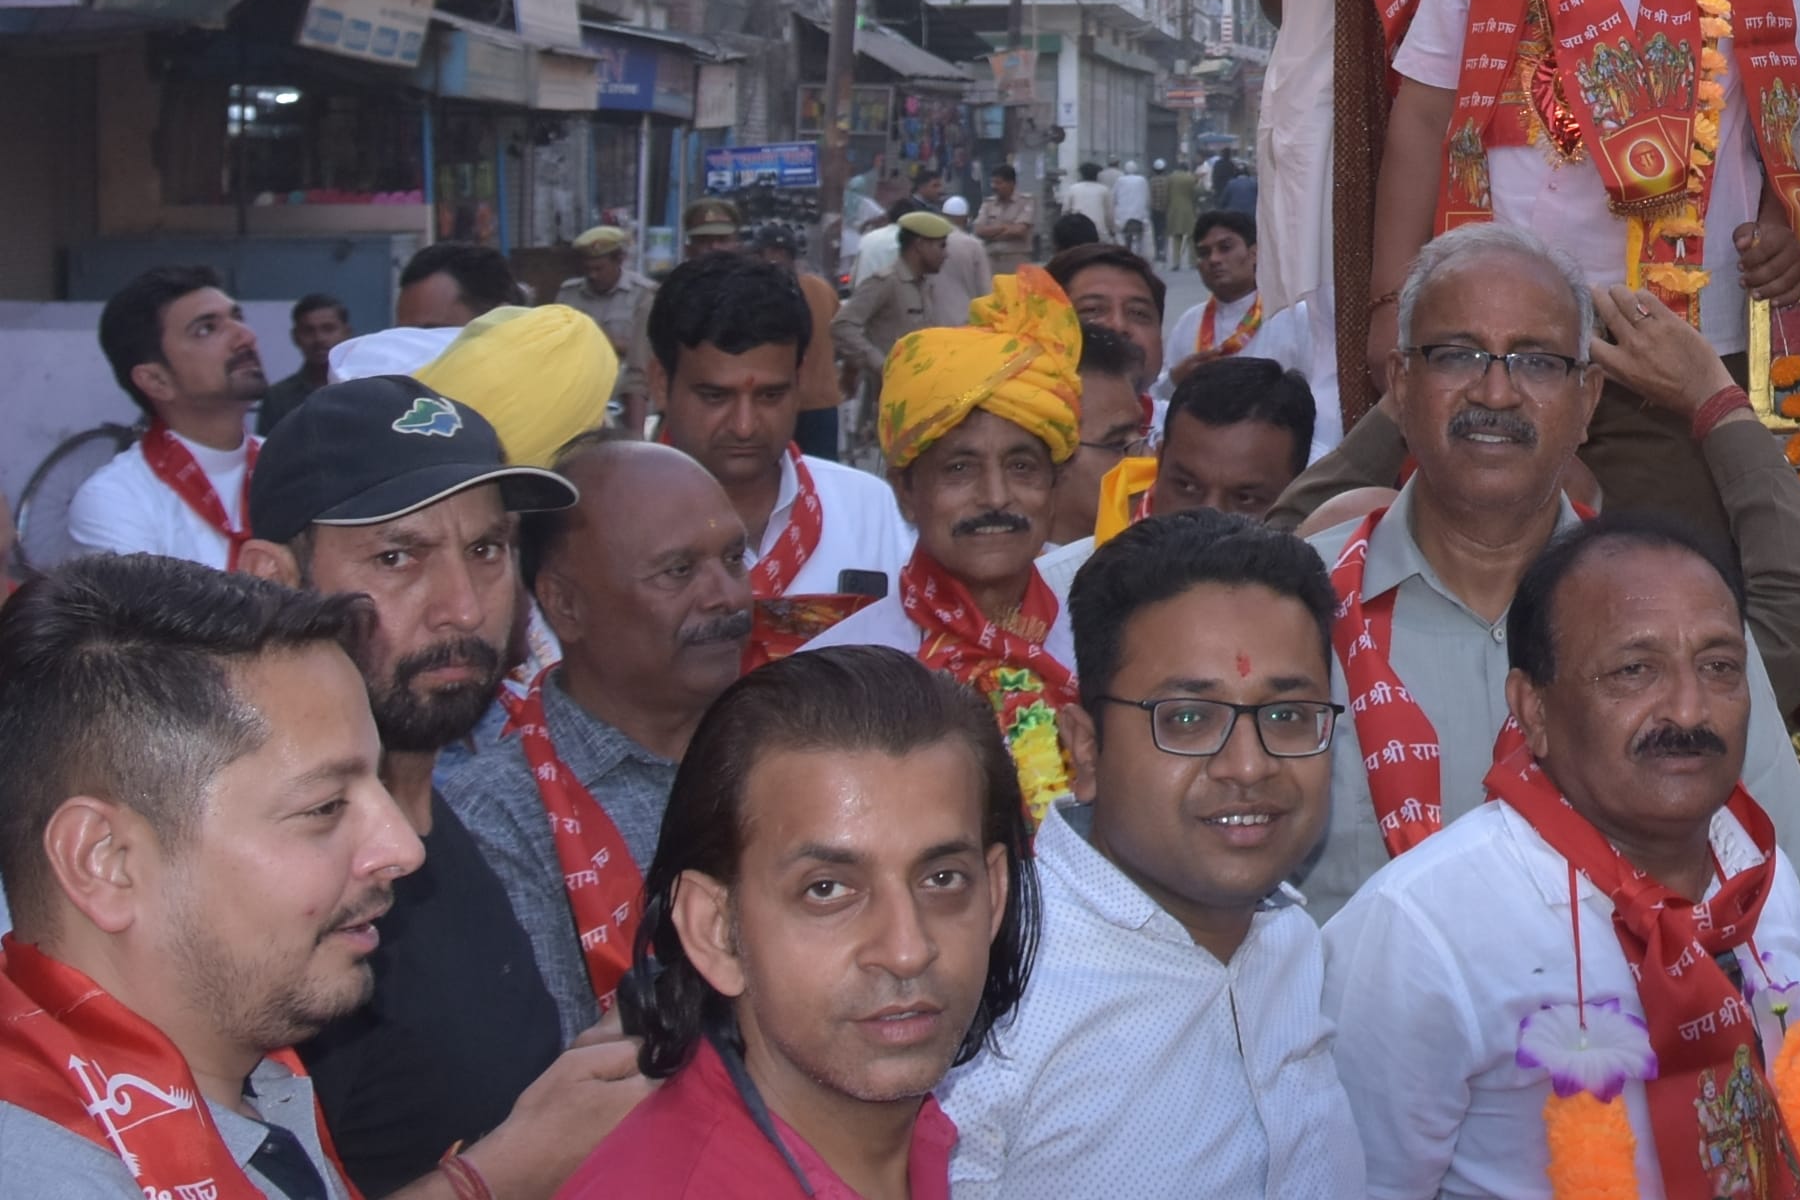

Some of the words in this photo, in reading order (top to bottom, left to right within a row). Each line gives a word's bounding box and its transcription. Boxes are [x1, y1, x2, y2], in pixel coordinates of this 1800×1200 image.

[1560, 32, 1583, 49] जय
[1584, 22, 1599, 41] श्री
[1599, 12, 1622, 32] राम
[1369, 681, 1392, 705] श्री
[1382, 739, 1405, 765] श्री
[1400, 797, 1423, 823] श्री
[565, 869, 599, 891] राम
[1678, 1014, 1718, 1043] जय
[1719, 995, 1743, 1029] श्री
